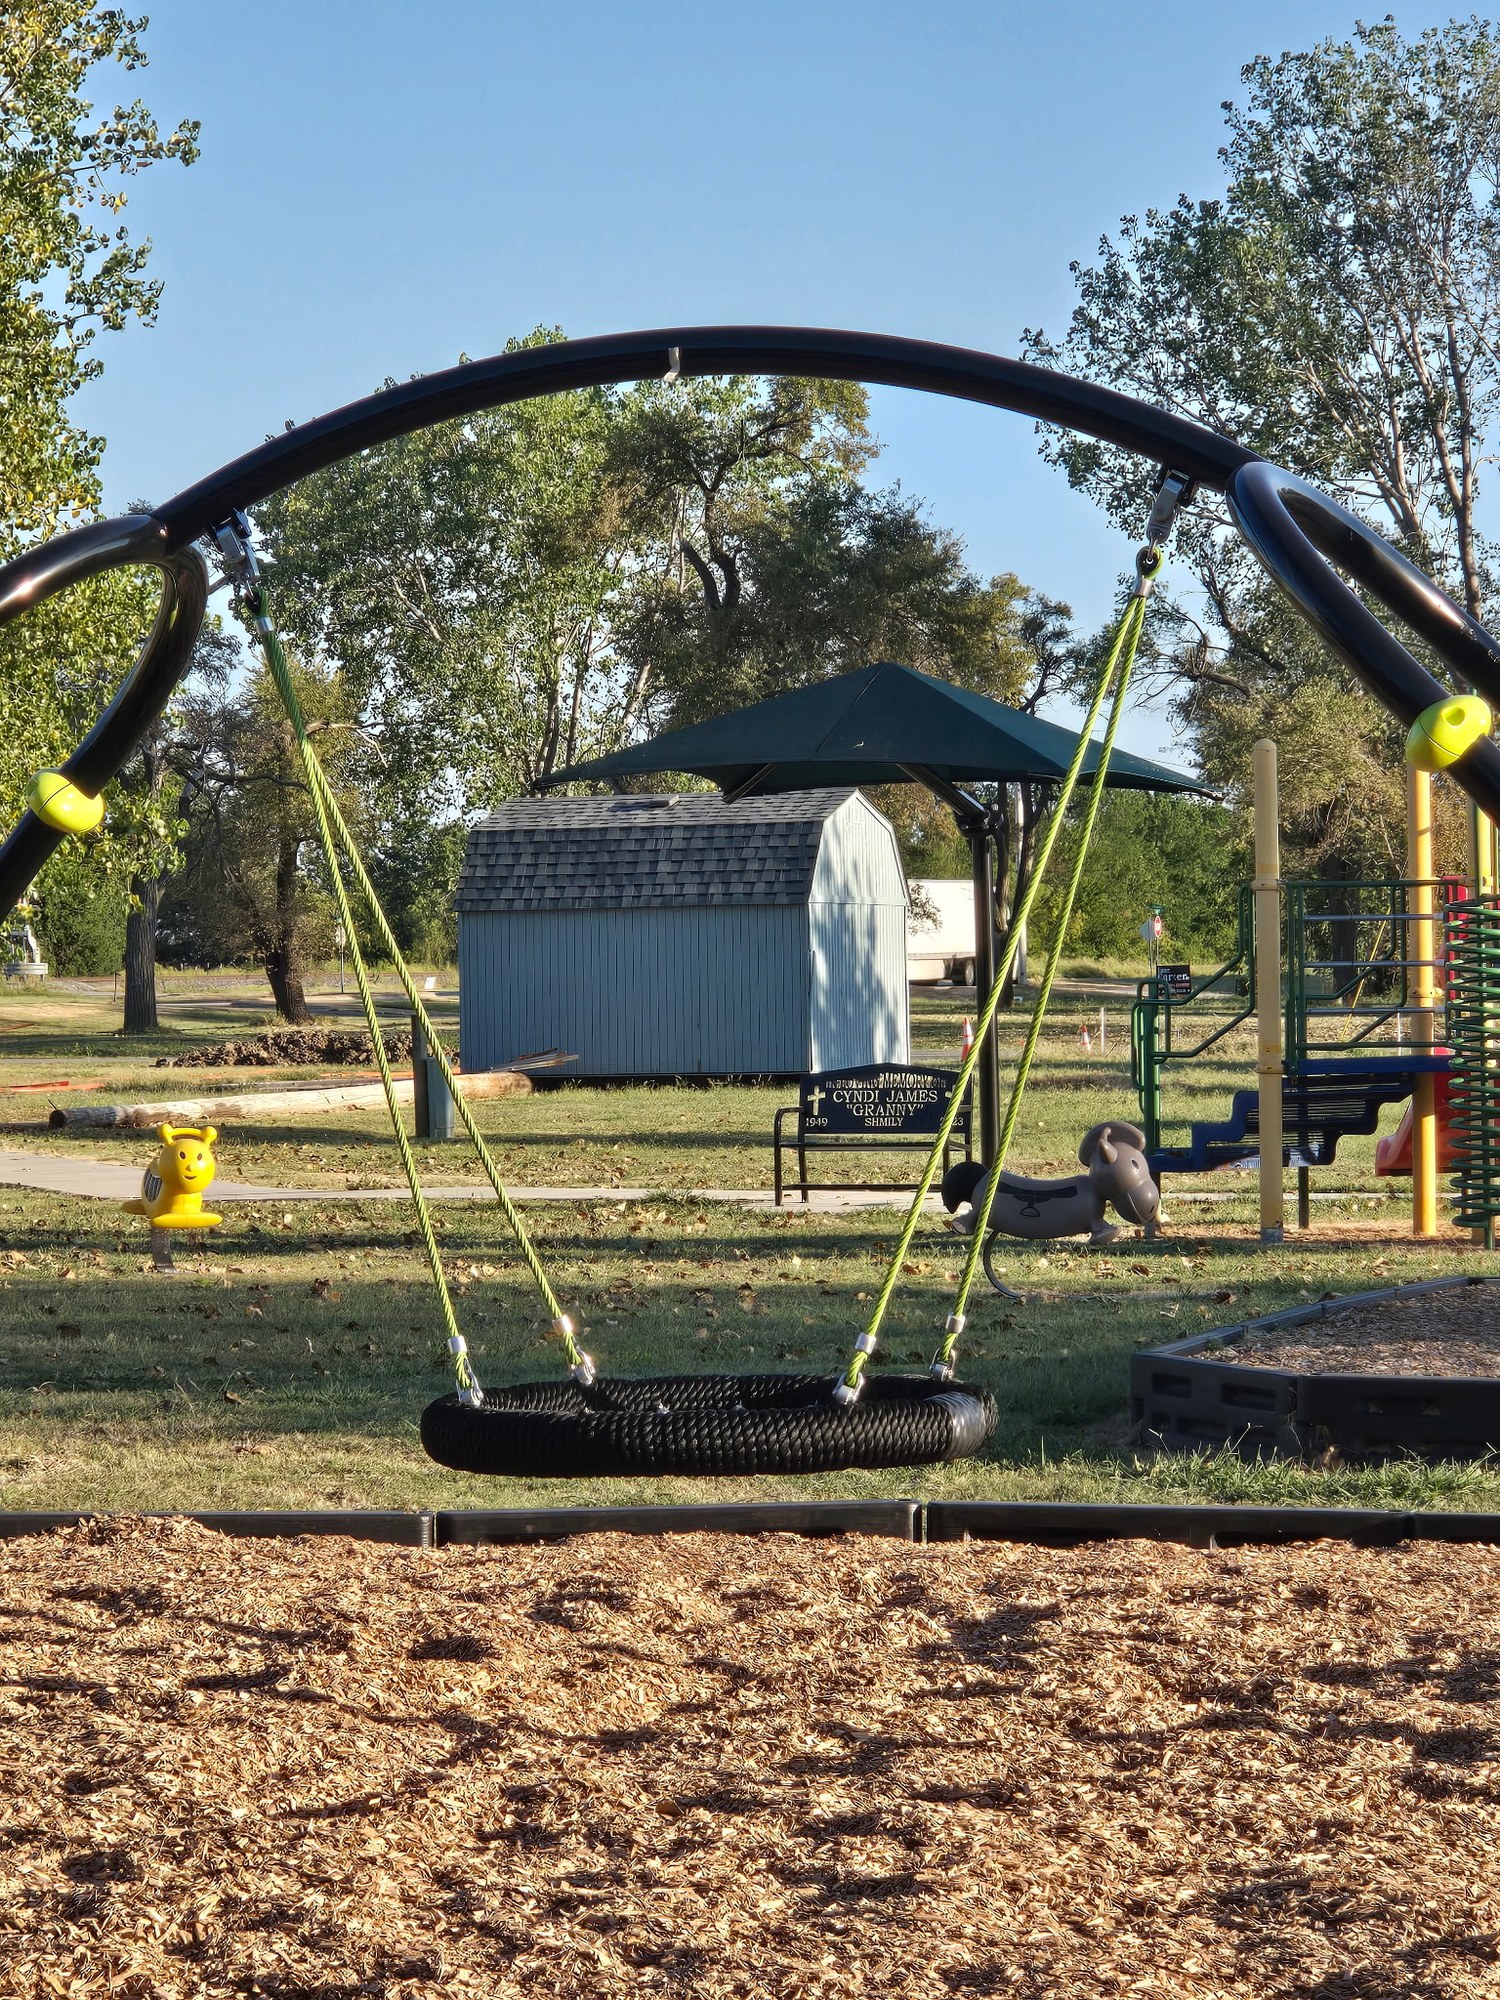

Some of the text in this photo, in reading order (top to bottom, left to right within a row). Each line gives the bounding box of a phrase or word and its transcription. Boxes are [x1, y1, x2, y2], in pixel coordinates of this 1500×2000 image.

[881, 1072, 927, 1089] MEMORY
[832, 1090, 938, 1103] CYNDI JAMES
[846, 1104, 924, 1116] "GRANNY"
[805, 1117, 828, 1127] 1949
[864, 1117, 904, 1127] SHMILY
[939, 1116, 964, 1126] 223
